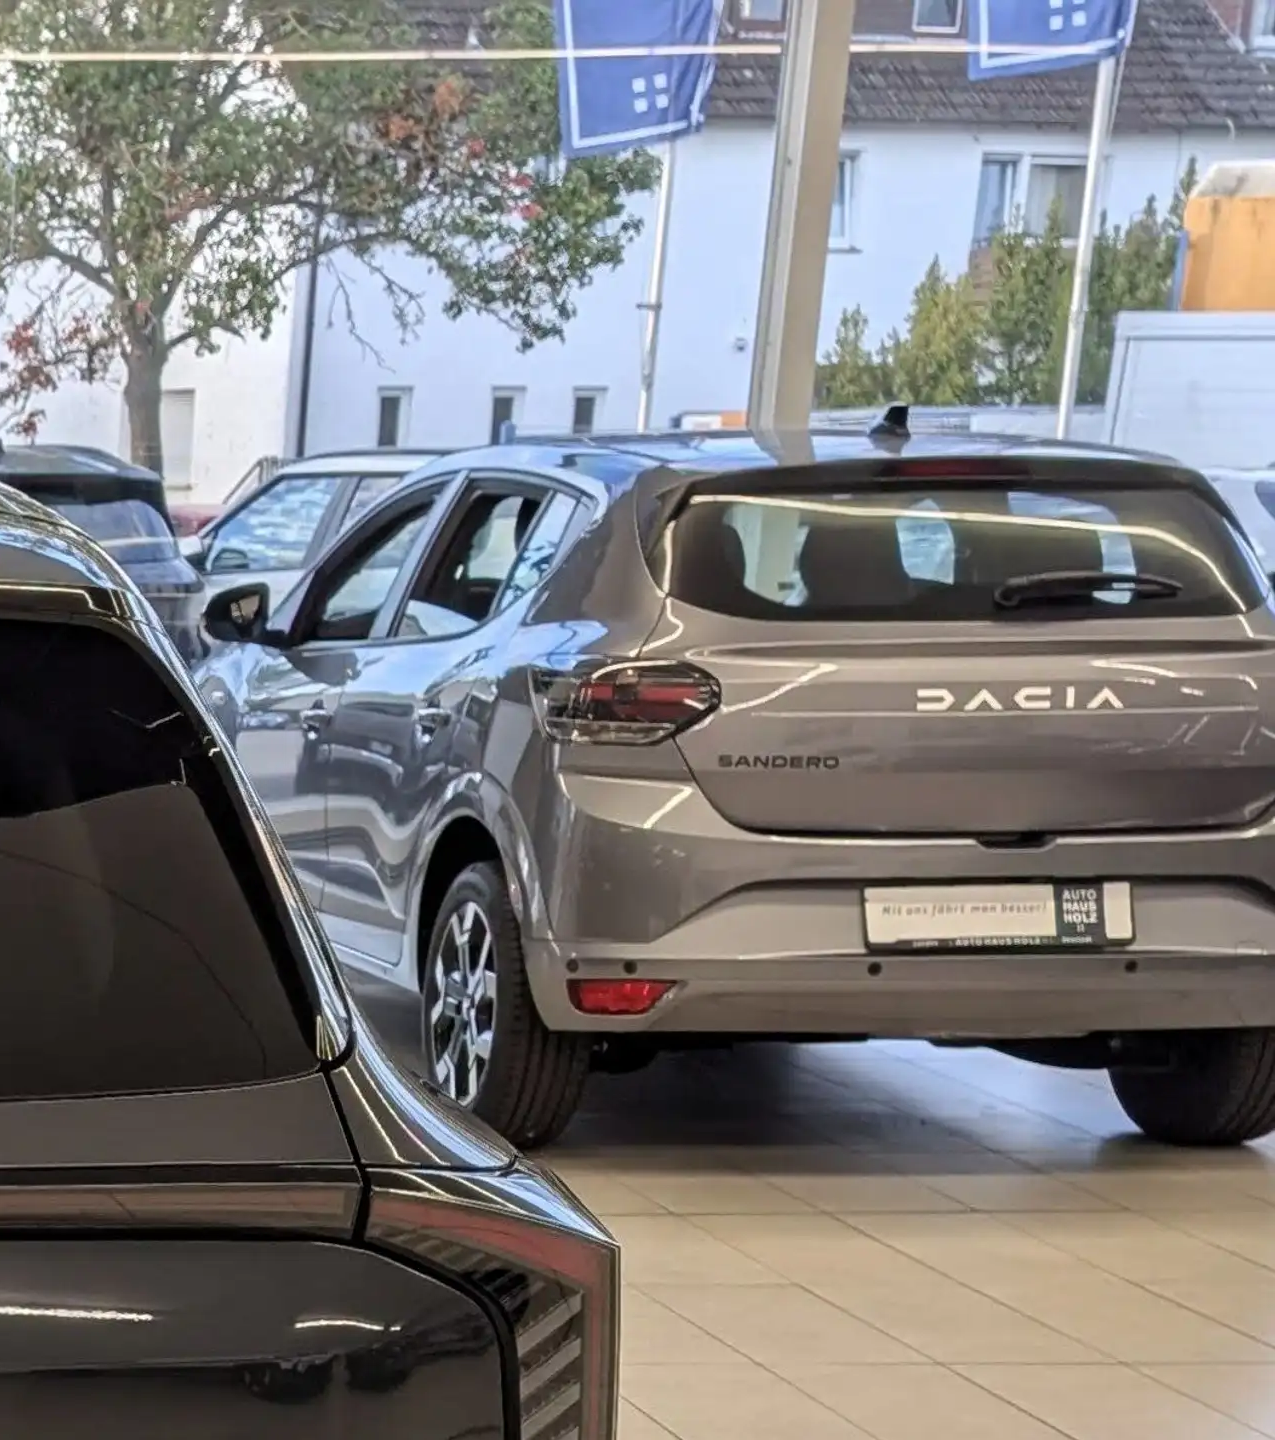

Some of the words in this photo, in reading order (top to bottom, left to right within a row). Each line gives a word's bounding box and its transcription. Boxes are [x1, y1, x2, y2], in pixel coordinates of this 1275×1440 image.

[916, 686, 1125, 712] DACIA
[717, 754, 840, 770] SANDERO
[1062, 888, 1097, 900] AUTO
[1063, 901, 1097, 912] HAUS
[1063, 912, 1098, 923] HOLZ
